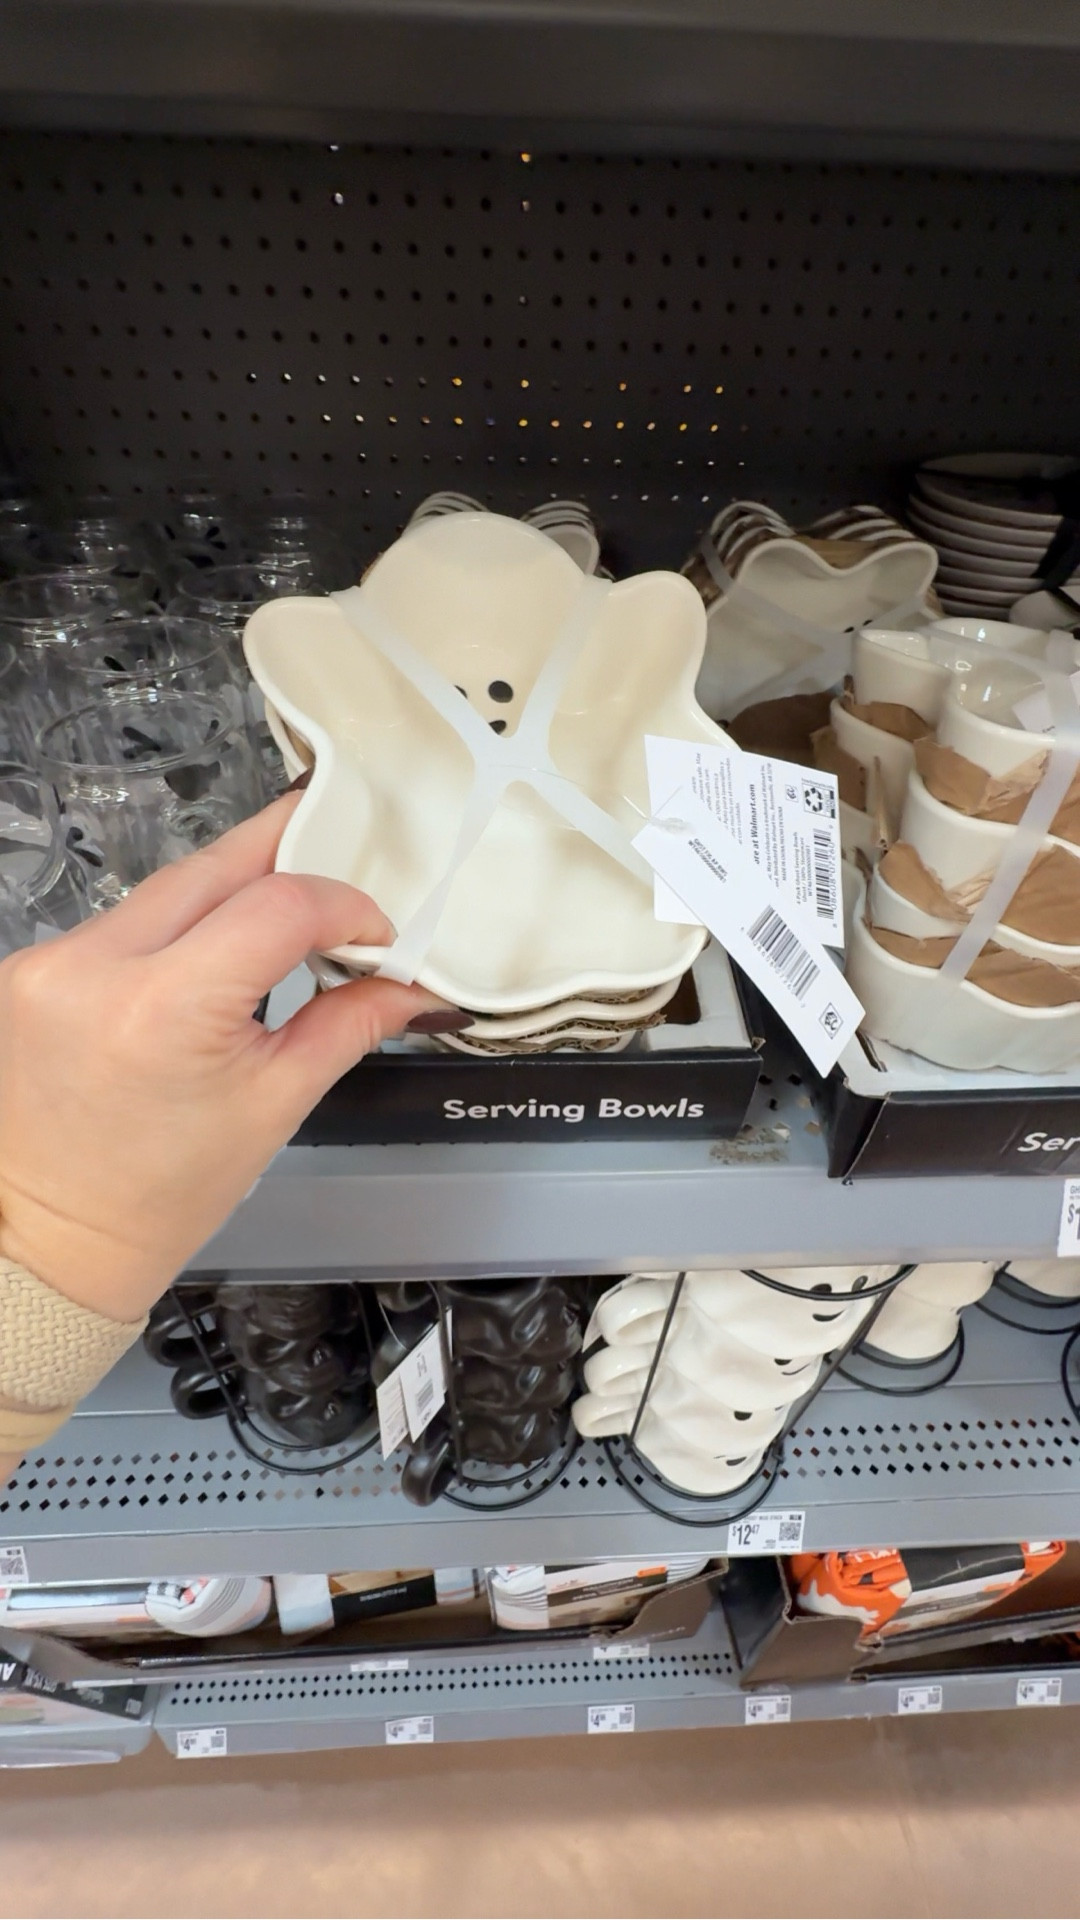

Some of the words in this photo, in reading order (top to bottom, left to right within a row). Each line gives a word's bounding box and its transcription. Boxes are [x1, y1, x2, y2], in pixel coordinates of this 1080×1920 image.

[750, 784, 769, 838] Walmart.com
[753, 840, 764, 849] at
[443, 1099, 584, 1123] Serving
[598, 1098, 704, 1118] Bowls
[1017, 1132, 1080, 1153] Ser
